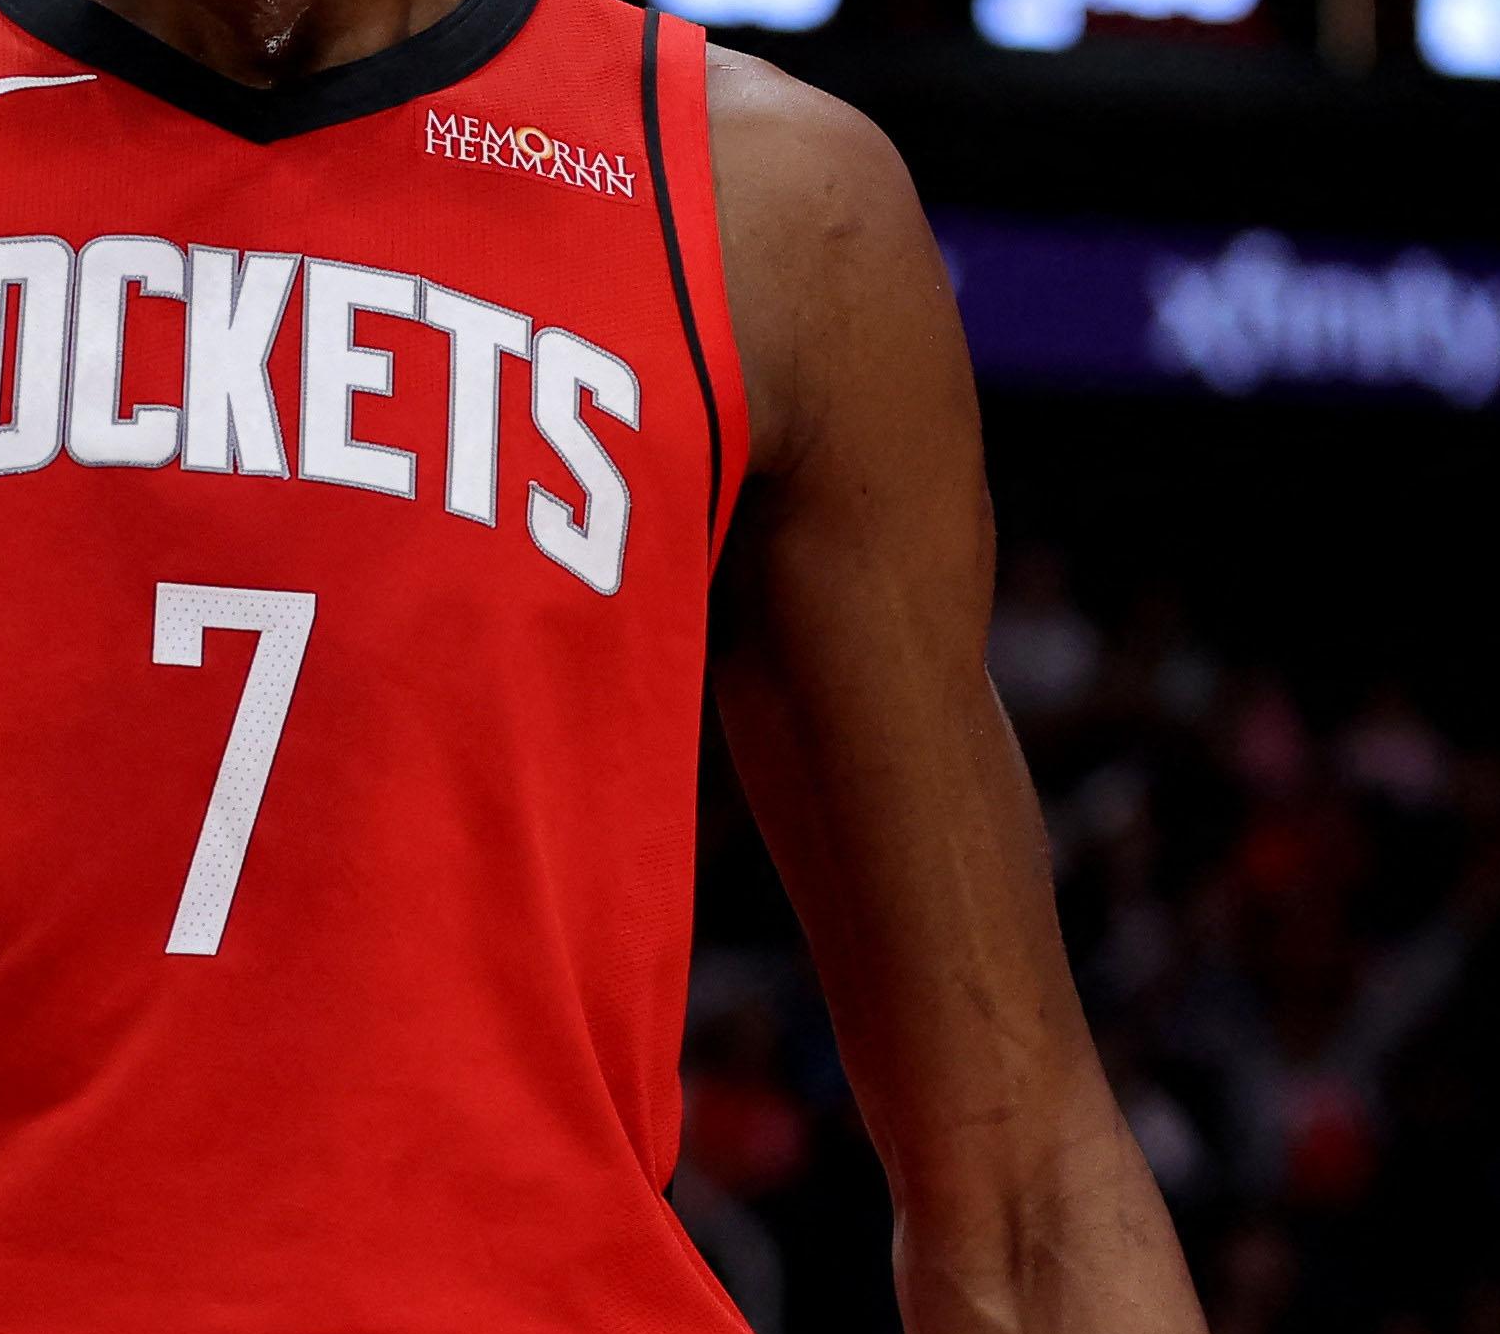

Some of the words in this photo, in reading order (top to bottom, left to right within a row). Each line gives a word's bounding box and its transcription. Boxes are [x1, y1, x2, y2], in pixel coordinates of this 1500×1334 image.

[424, 109, 636, 179] MEMORIAL
[424, 130, 635, 198] HERMANN
[151, 581, 317, 957] 7
